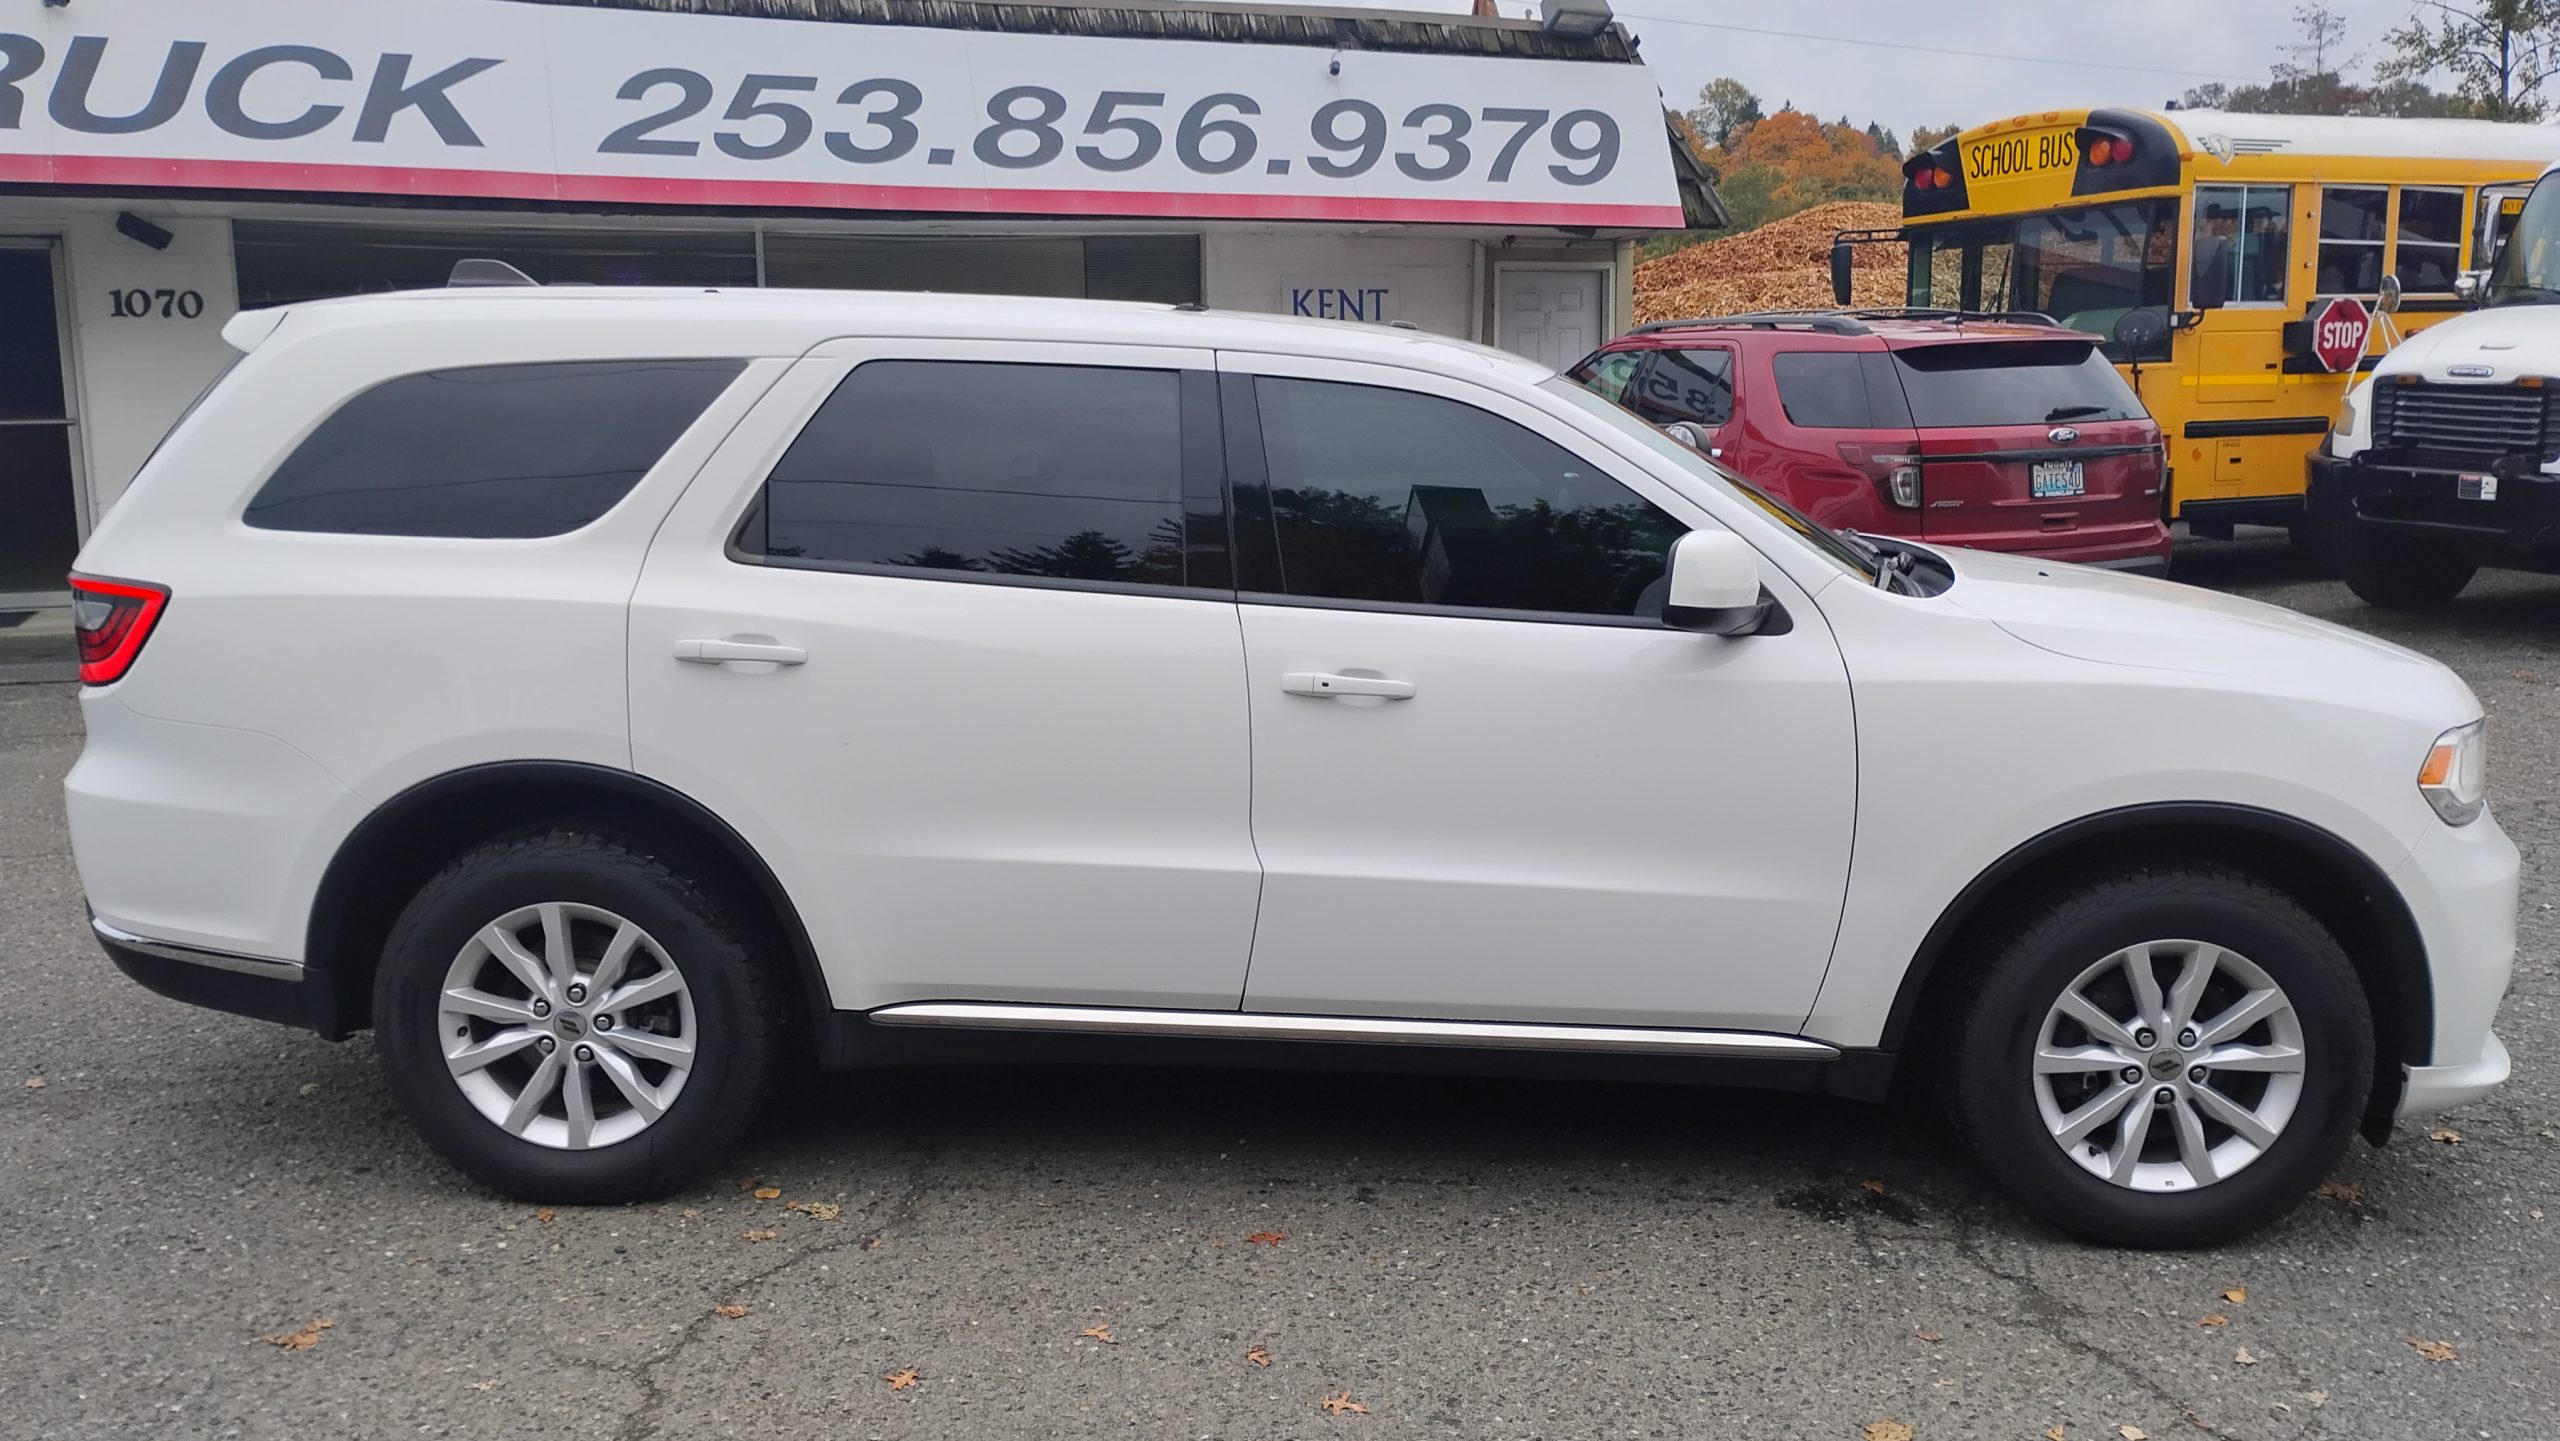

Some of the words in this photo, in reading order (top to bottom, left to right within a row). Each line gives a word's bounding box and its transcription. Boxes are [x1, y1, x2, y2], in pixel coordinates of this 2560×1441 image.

[597, 67, 1620, 186] 253.856.9379
[1971, 139, 2033, 179] SCHOOL
[2039, 131, 2074, 169] BUS
[109, 289, 204, 319] 1070
[1292, 289, 1389, 321] KENT
[2323, 321, 2363, 349] STOP
[2057, 430, 2075, 441] Ford
[2035, 472, 2081, 490] GATES4U
